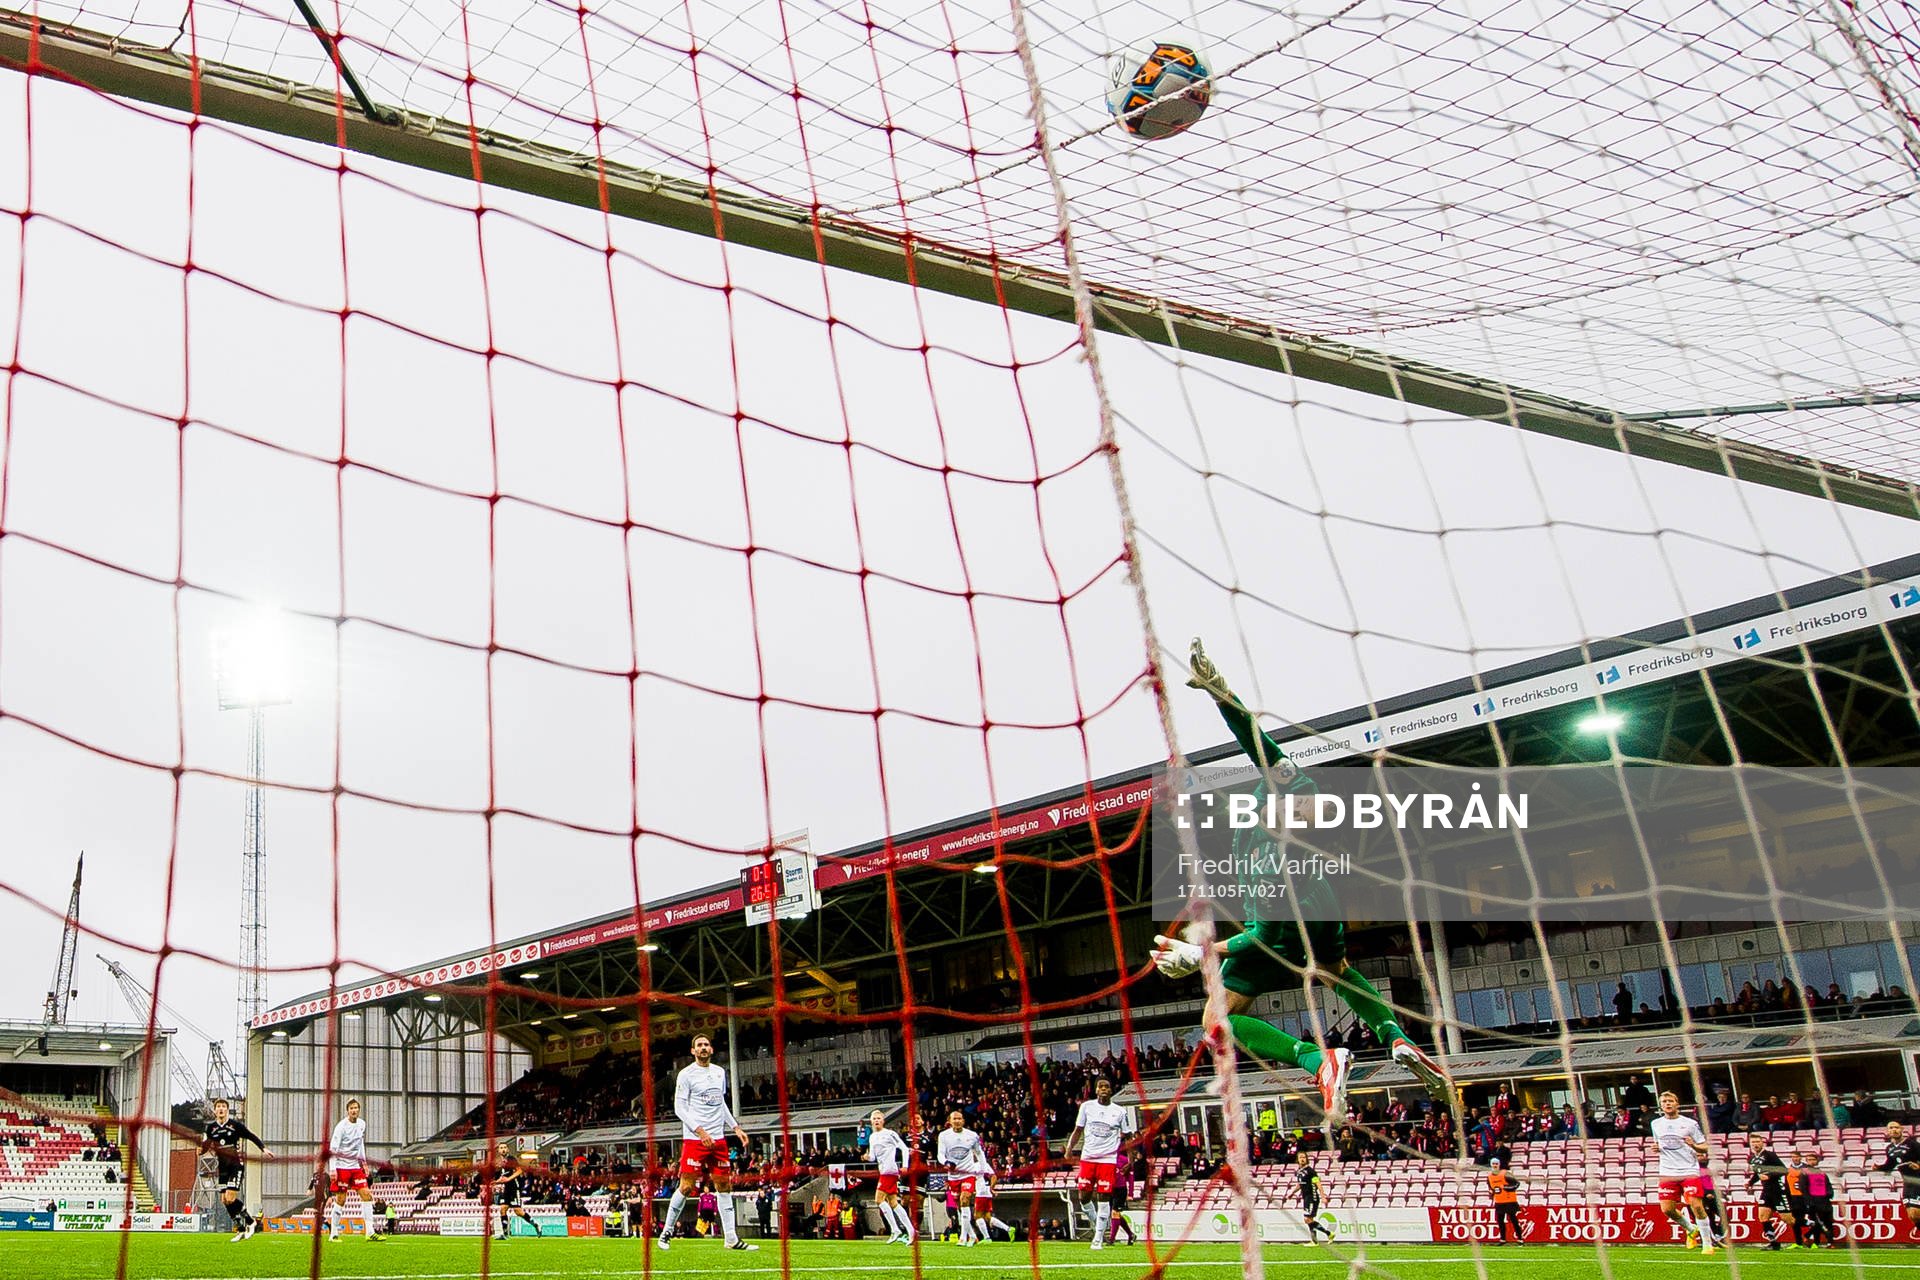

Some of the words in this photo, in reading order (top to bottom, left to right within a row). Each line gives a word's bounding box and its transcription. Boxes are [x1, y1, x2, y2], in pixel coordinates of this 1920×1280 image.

[1770, 606, 1868, 639] Fredriksborg
[1627, 646, 1714, 676] Fredriksborg
[1501, 681, 1578, 708] Fredriksborg
[1390, 711, 1458, 736] Fredriksborg
[1289, 739, 1350, 760] Fredriksborg
[1062, 793, 1123, 820] Fredrkstad
[1126, 782, 1162, 803] energ
[902, 845, 930, 862] energi
[673, 902, 708, 920] Fredrikstad
[709, 897, 730, 911] energi
[550, 936, 578, 951] Fredrikstad
[579, 931, 596, 944] energi
[133, 1215, 150, 1224] Solid
[174, 1216, 192, 1224] Solid
[1546, 1206, 1626, 1224] MULTI
[1832, 1203, 1902, 1221] ULTI
[1133, 1222, 1164, 1238] brng
[1549, 1224, 1620, 1240] FOOD
[1670, 1223, 1750, 1240] FD
[1832, 1222, 1896, 1240] OOD
